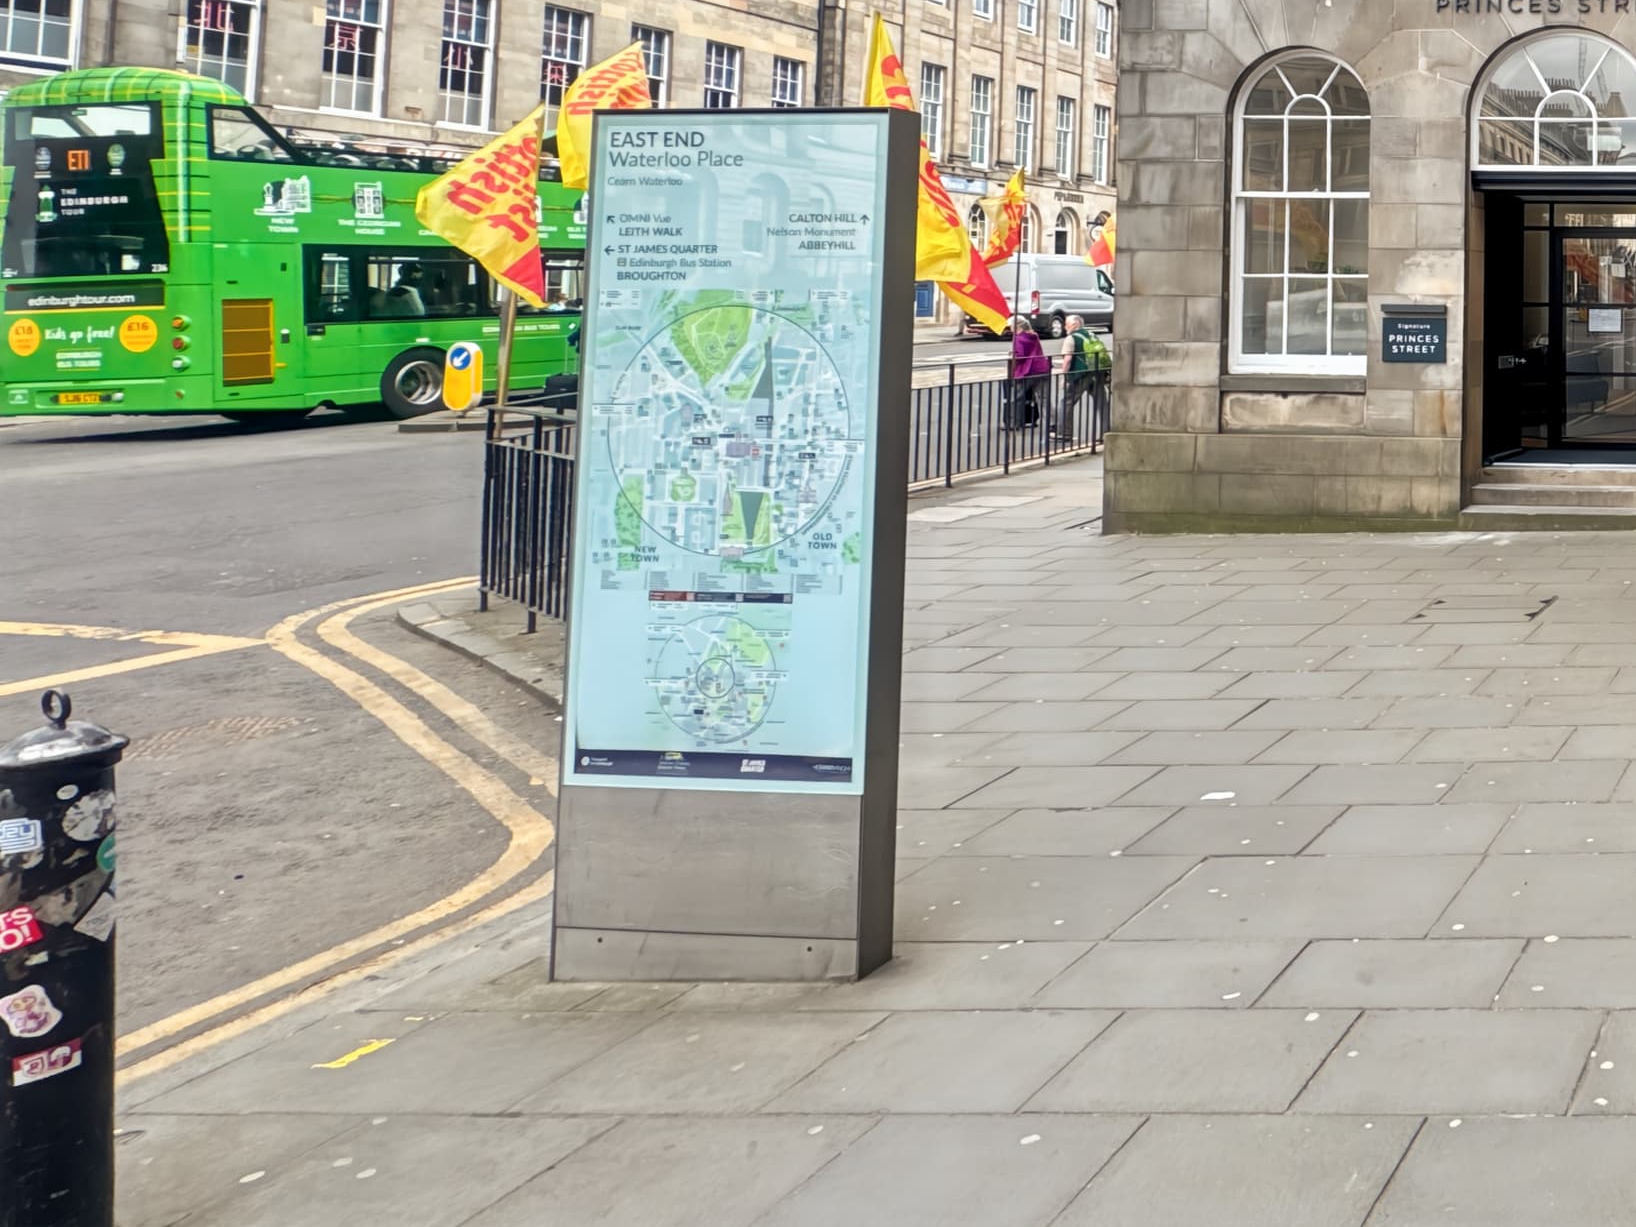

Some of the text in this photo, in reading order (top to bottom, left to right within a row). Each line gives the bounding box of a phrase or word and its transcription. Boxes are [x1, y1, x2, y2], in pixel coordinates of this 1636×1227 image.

[610, 131, 705, 147] EAST END
[609, 150, 744, 167] Waterloo Place
[639, 176, 683, 186] Waterloo
[653, 214, 671, 223] Vue
[789, 214, 857, 222] CALTON HILL
[618, 227, 683, 236] LEITH WALK
[767, 227, 856, 236] Nelson Monument
[618, 244, 718, 255] ST JAMES QUARTER
[798, 241, 856, 250] ABBEYHILL
[629, 258, 732, 269] Edinburgh Bus Station
[617, 271, 687, 280] BROUGHTON
[28, 295, 136, 306] edinburghtour.com
[1388, 335, 1439, 343] PRINCES
[1392, 345, 1436, 353] STREET
[812, 533, 832, 541] OLD
[631, 555, 659, 563] TOWN
